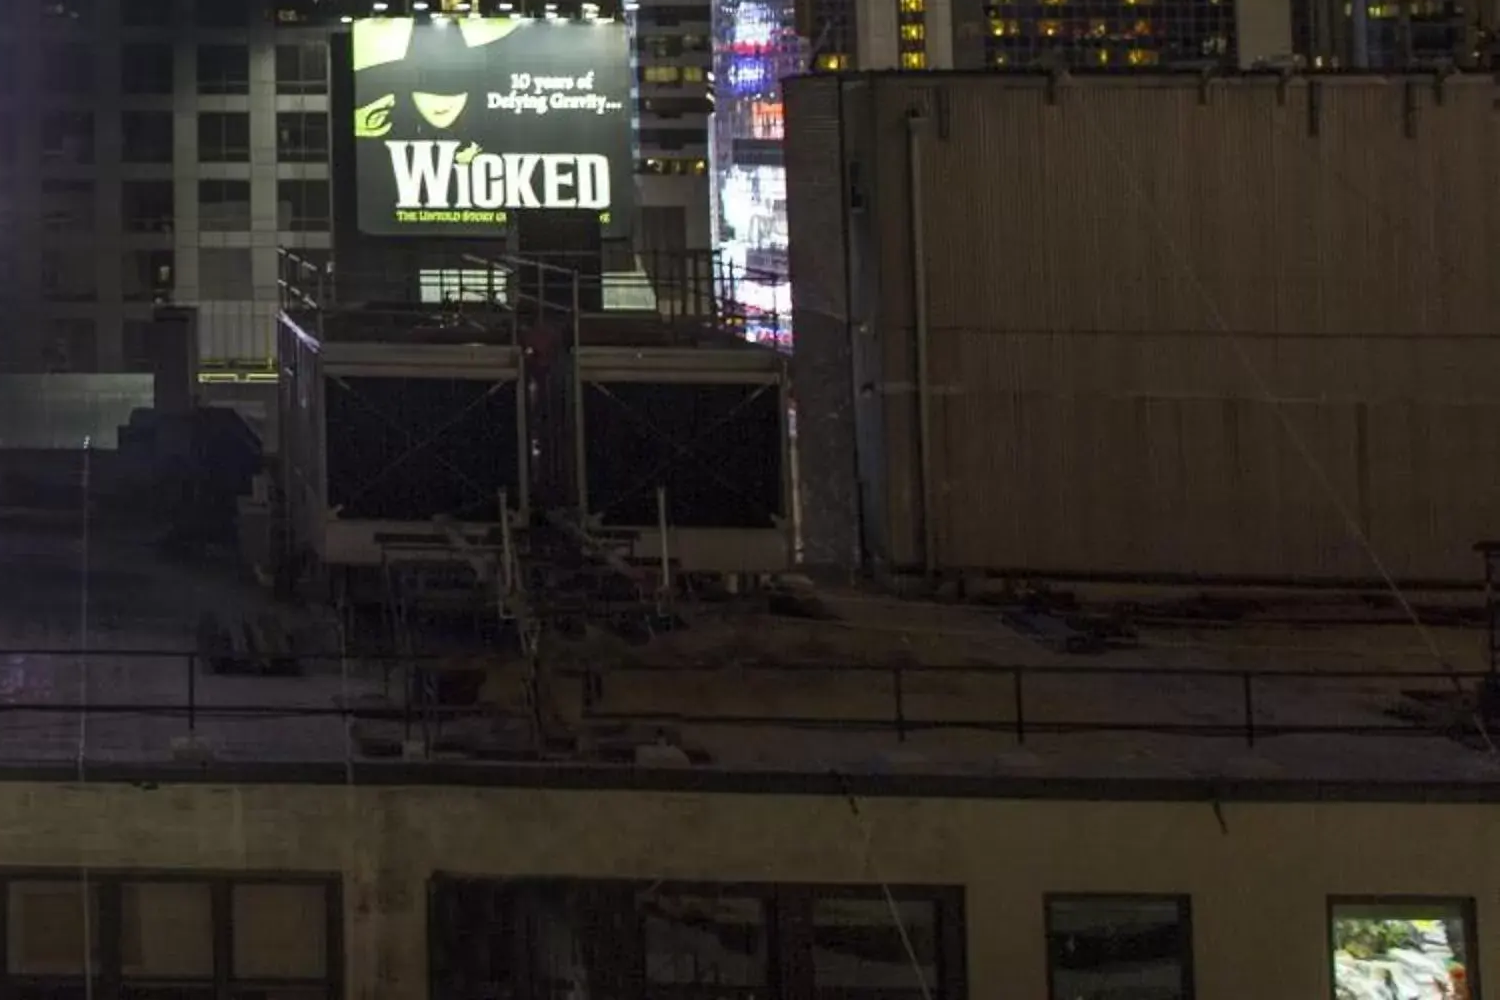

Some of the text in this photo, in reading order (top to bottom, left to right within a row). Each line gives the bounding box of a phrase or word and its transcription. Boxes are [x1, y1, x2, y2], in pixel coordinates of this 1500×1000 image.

[510, 69, 595, 95] 10 years of
[487, 89, 622, 114] Defying Gravity...
